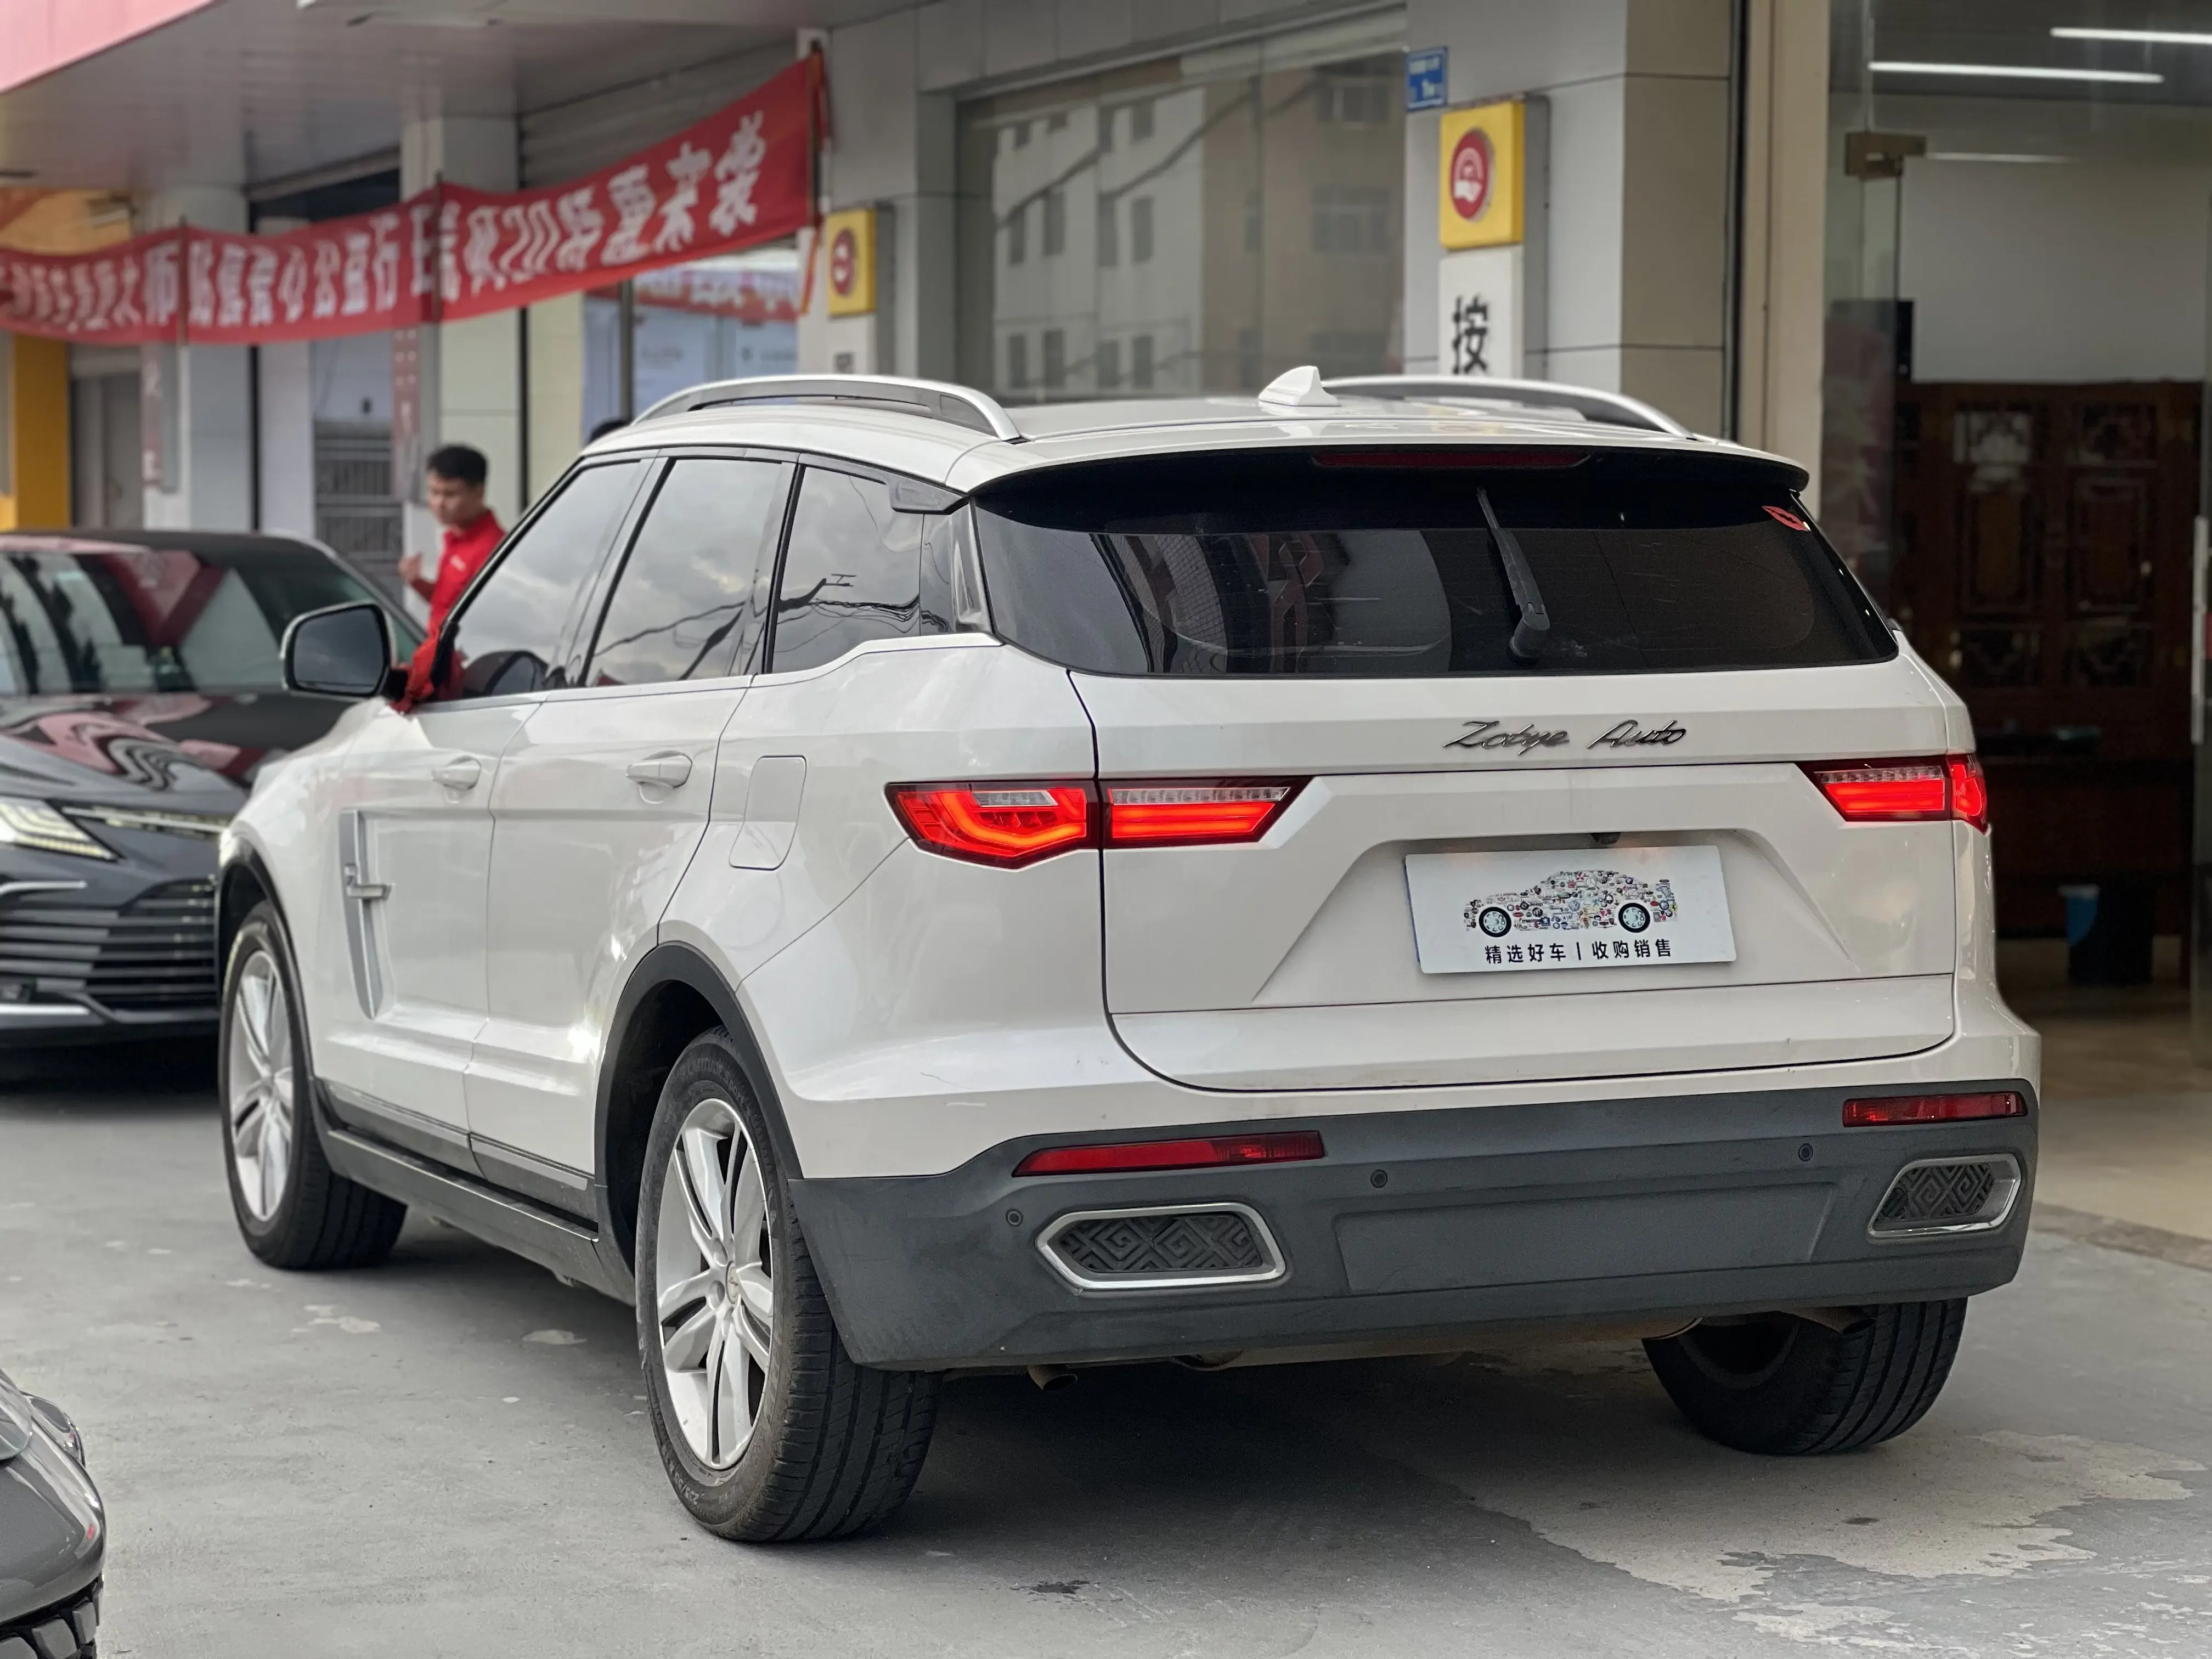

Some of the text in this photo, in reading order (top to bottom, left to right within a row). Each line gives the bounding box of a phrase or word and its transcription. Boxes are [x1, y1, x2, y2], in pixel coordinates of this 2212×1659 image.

[1452, 296, 1488, 375] 按
[1443, 720, 1686, 756] Zotye Auto
[1485, 939, 1671, 964] 精选好车 收购销售
